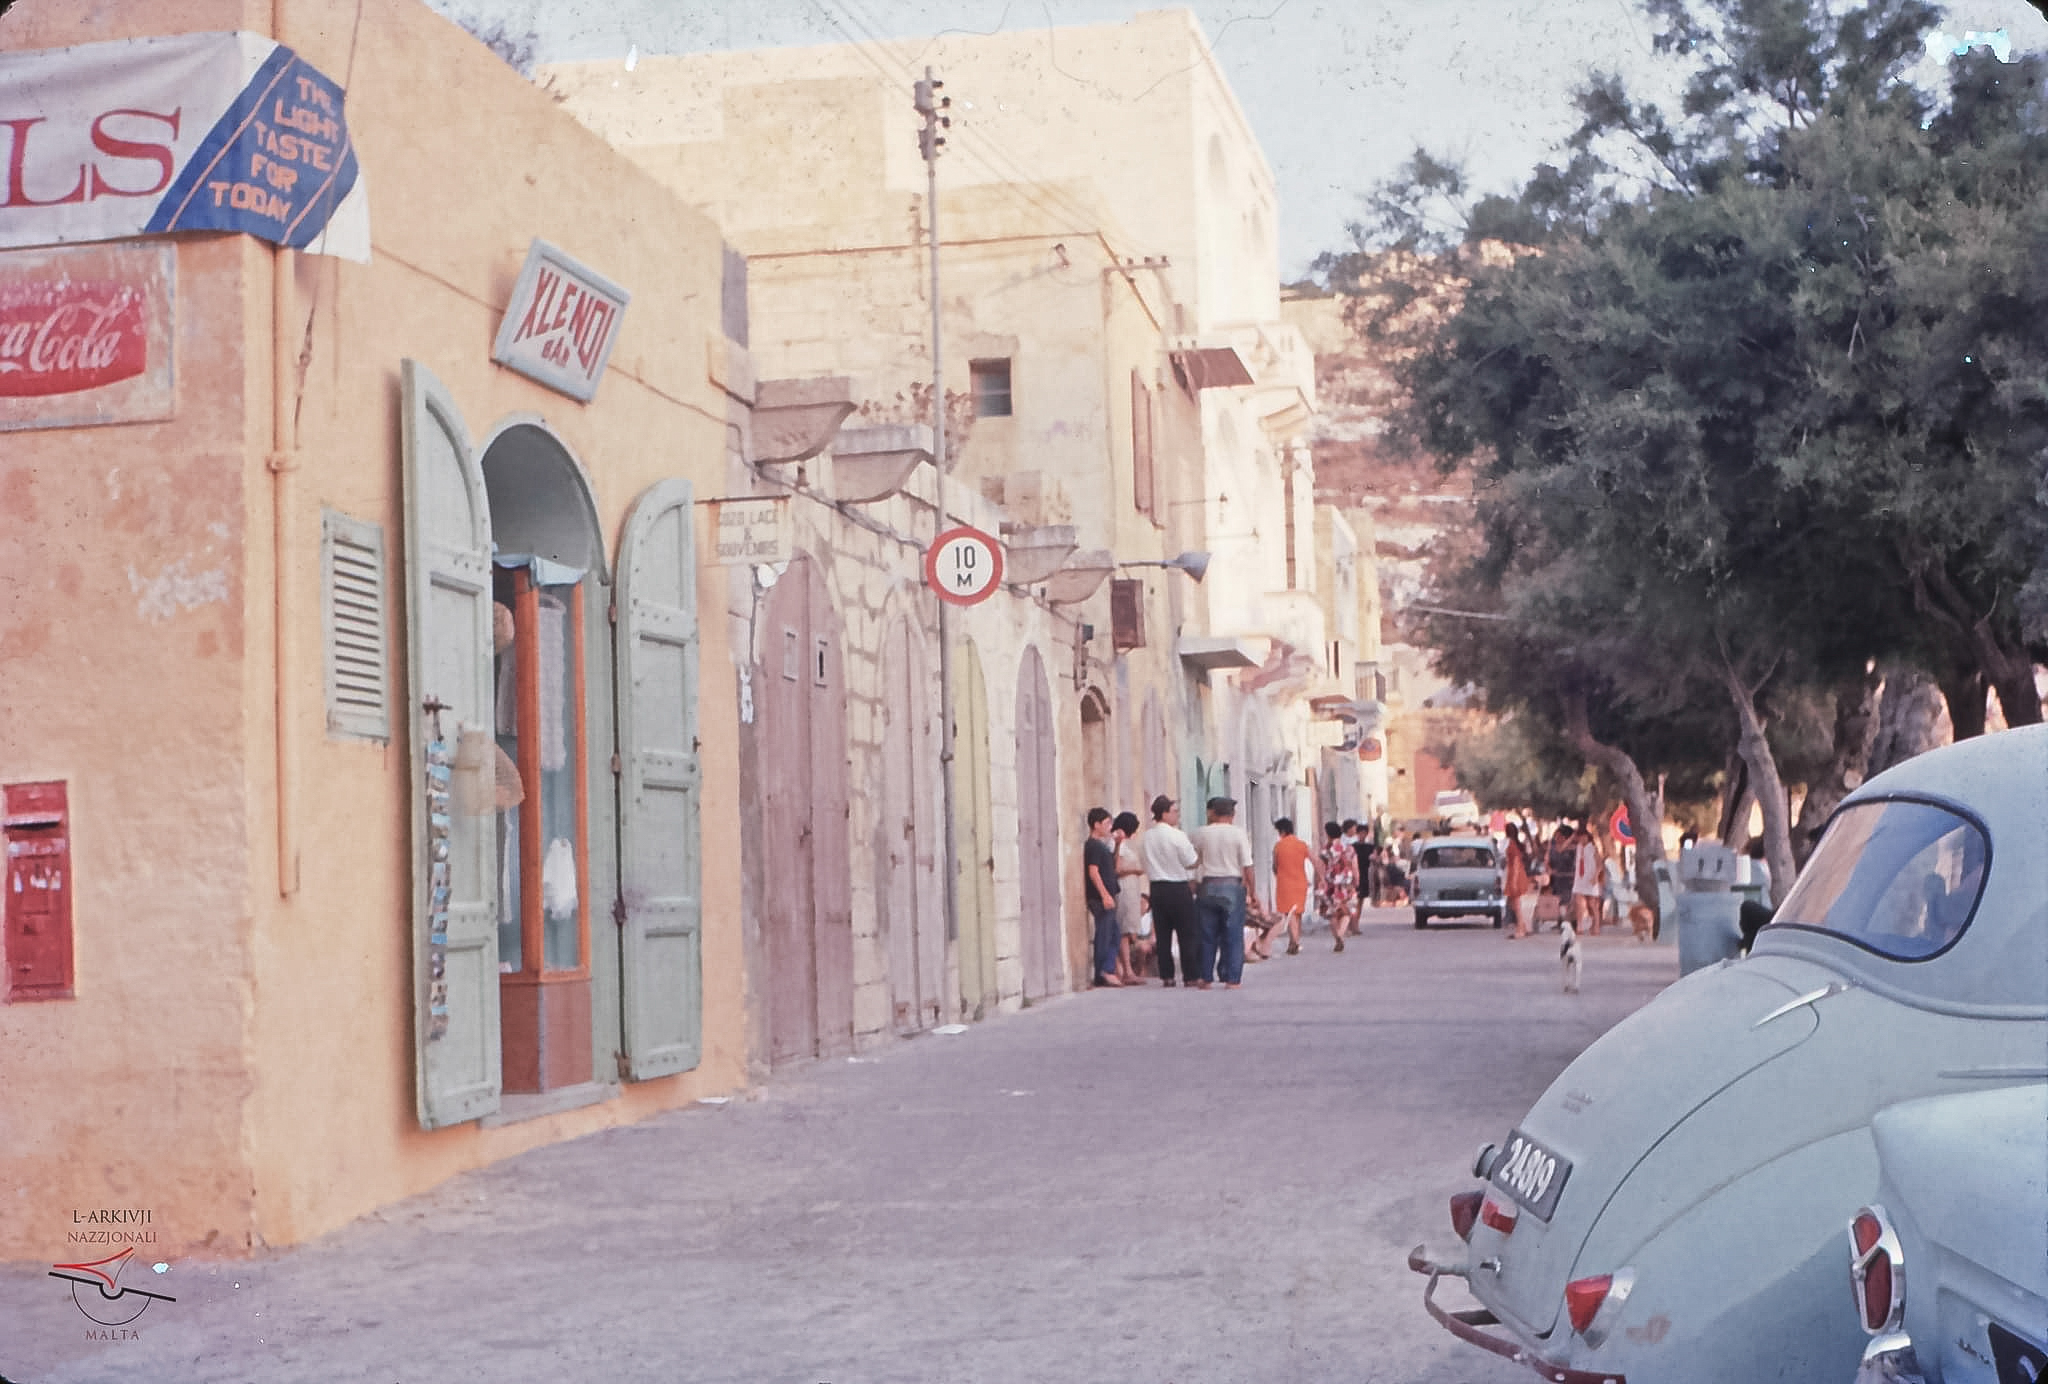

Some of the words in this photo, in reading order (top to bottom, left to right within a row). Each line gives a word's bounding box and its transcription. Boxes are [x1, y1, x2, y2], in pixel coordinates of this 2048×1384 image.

[274, 97, 340, 144] LIGHT
[254, 120, 333, 172] TASTE
[251, 153, 298, 193] FOR
[208, 181, 293, 223] TODAY
[513, 266, 617, 381] XLENDI
[955, 545, 976, 569] 10
[956, 573, 973, 588] M
